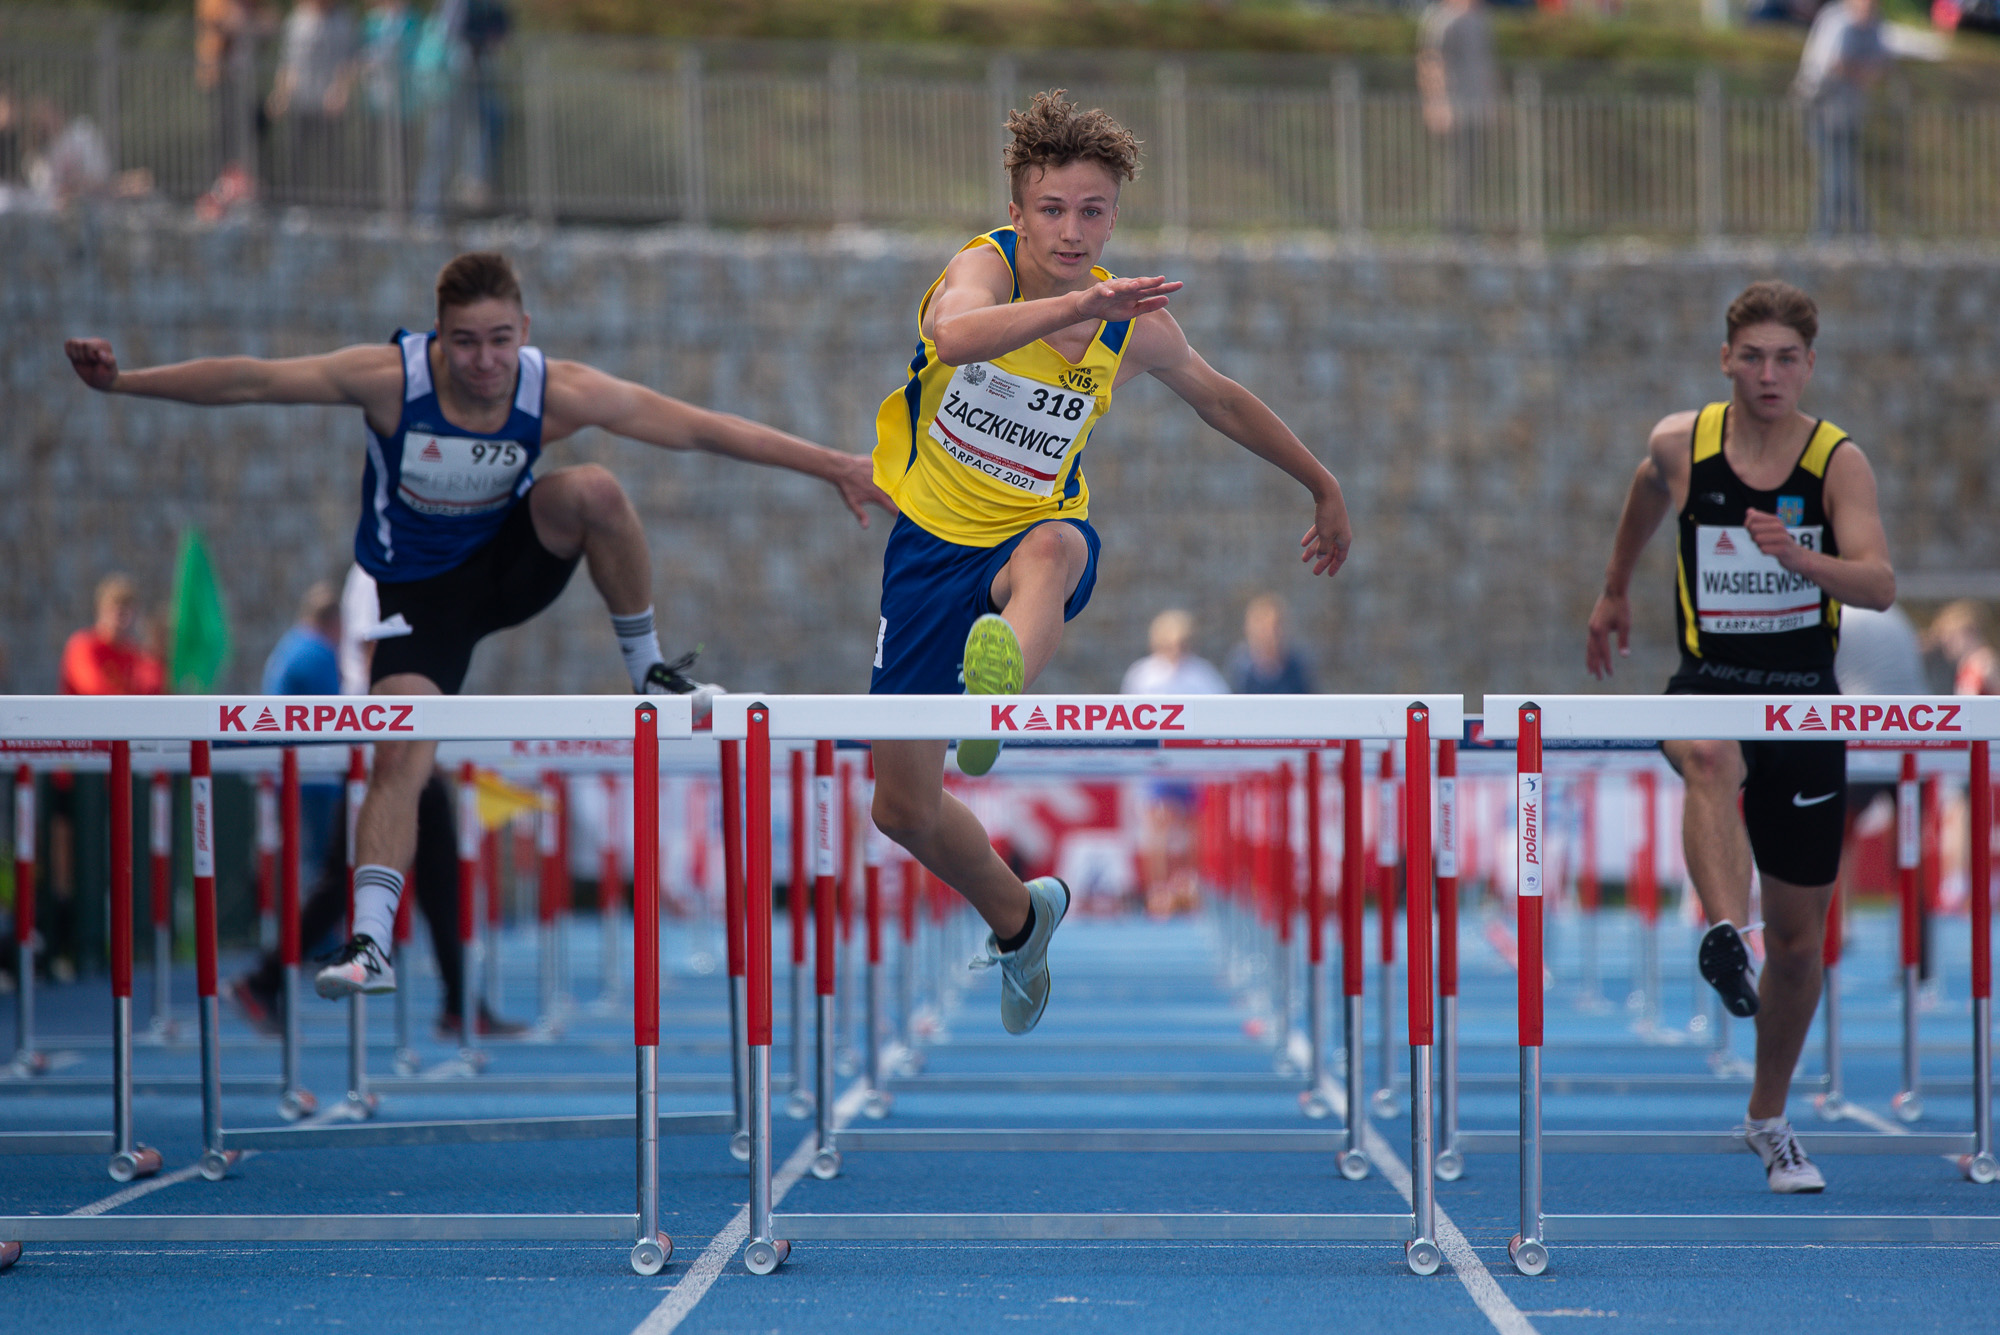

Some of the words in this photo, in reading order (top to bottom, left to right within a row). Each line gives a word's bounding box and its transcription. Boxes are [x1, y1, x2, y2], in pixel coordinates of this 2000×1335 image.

[1068, 370, 1092, 389] VIS
[1027, 388, 1085, 421] 318
[943, 390, 1072, 460] ŻACZKIEWICZ
[471, 444, 518, 466] 975
[942, 438, 1002, 478] KARPACZ
[1002, 471, 1036, 491] 2021
[1699, 661, 1764, 684] NIKE
[1765, 670, 1821, 688] PRO
[219, 704, 415, 732] KARPACZ
[990, 703, 1185, 732] KARPACZ
[1764, 703, 1962, 732] KARPACZ
[1522, 802, 1540, 866] polanik
